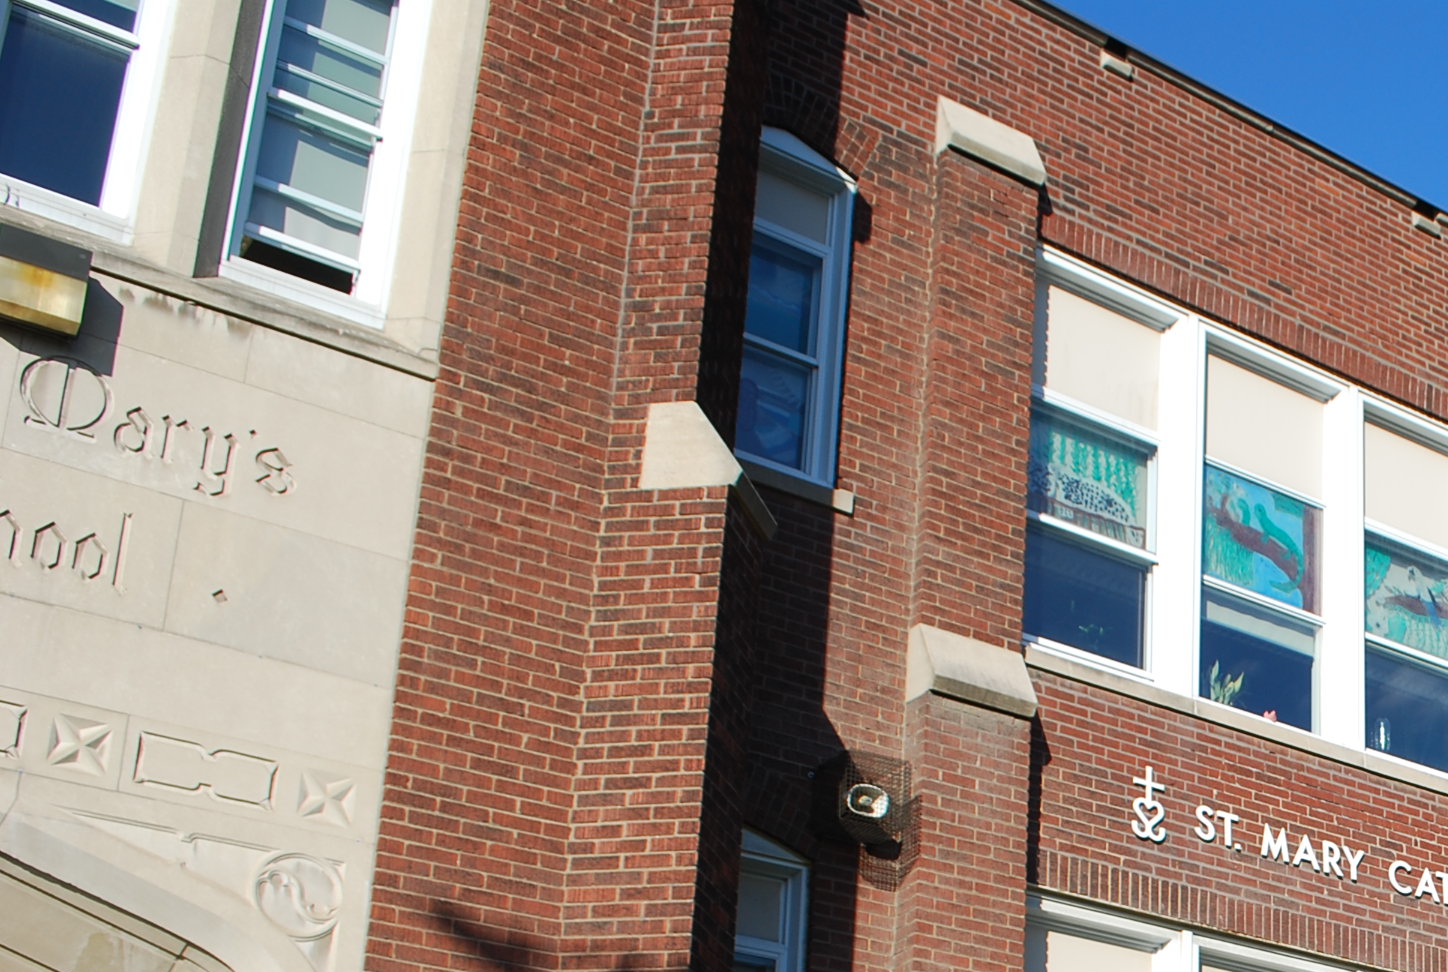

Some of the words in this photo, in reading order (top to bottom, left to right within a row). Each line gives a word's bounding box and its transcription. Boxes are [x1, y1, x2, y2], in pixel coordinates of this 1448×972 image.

[19, 354, 298, 497] Mary's
[1193, 805, 1242, 851] ST.
[1260, 822, 1365, 883] MARY
